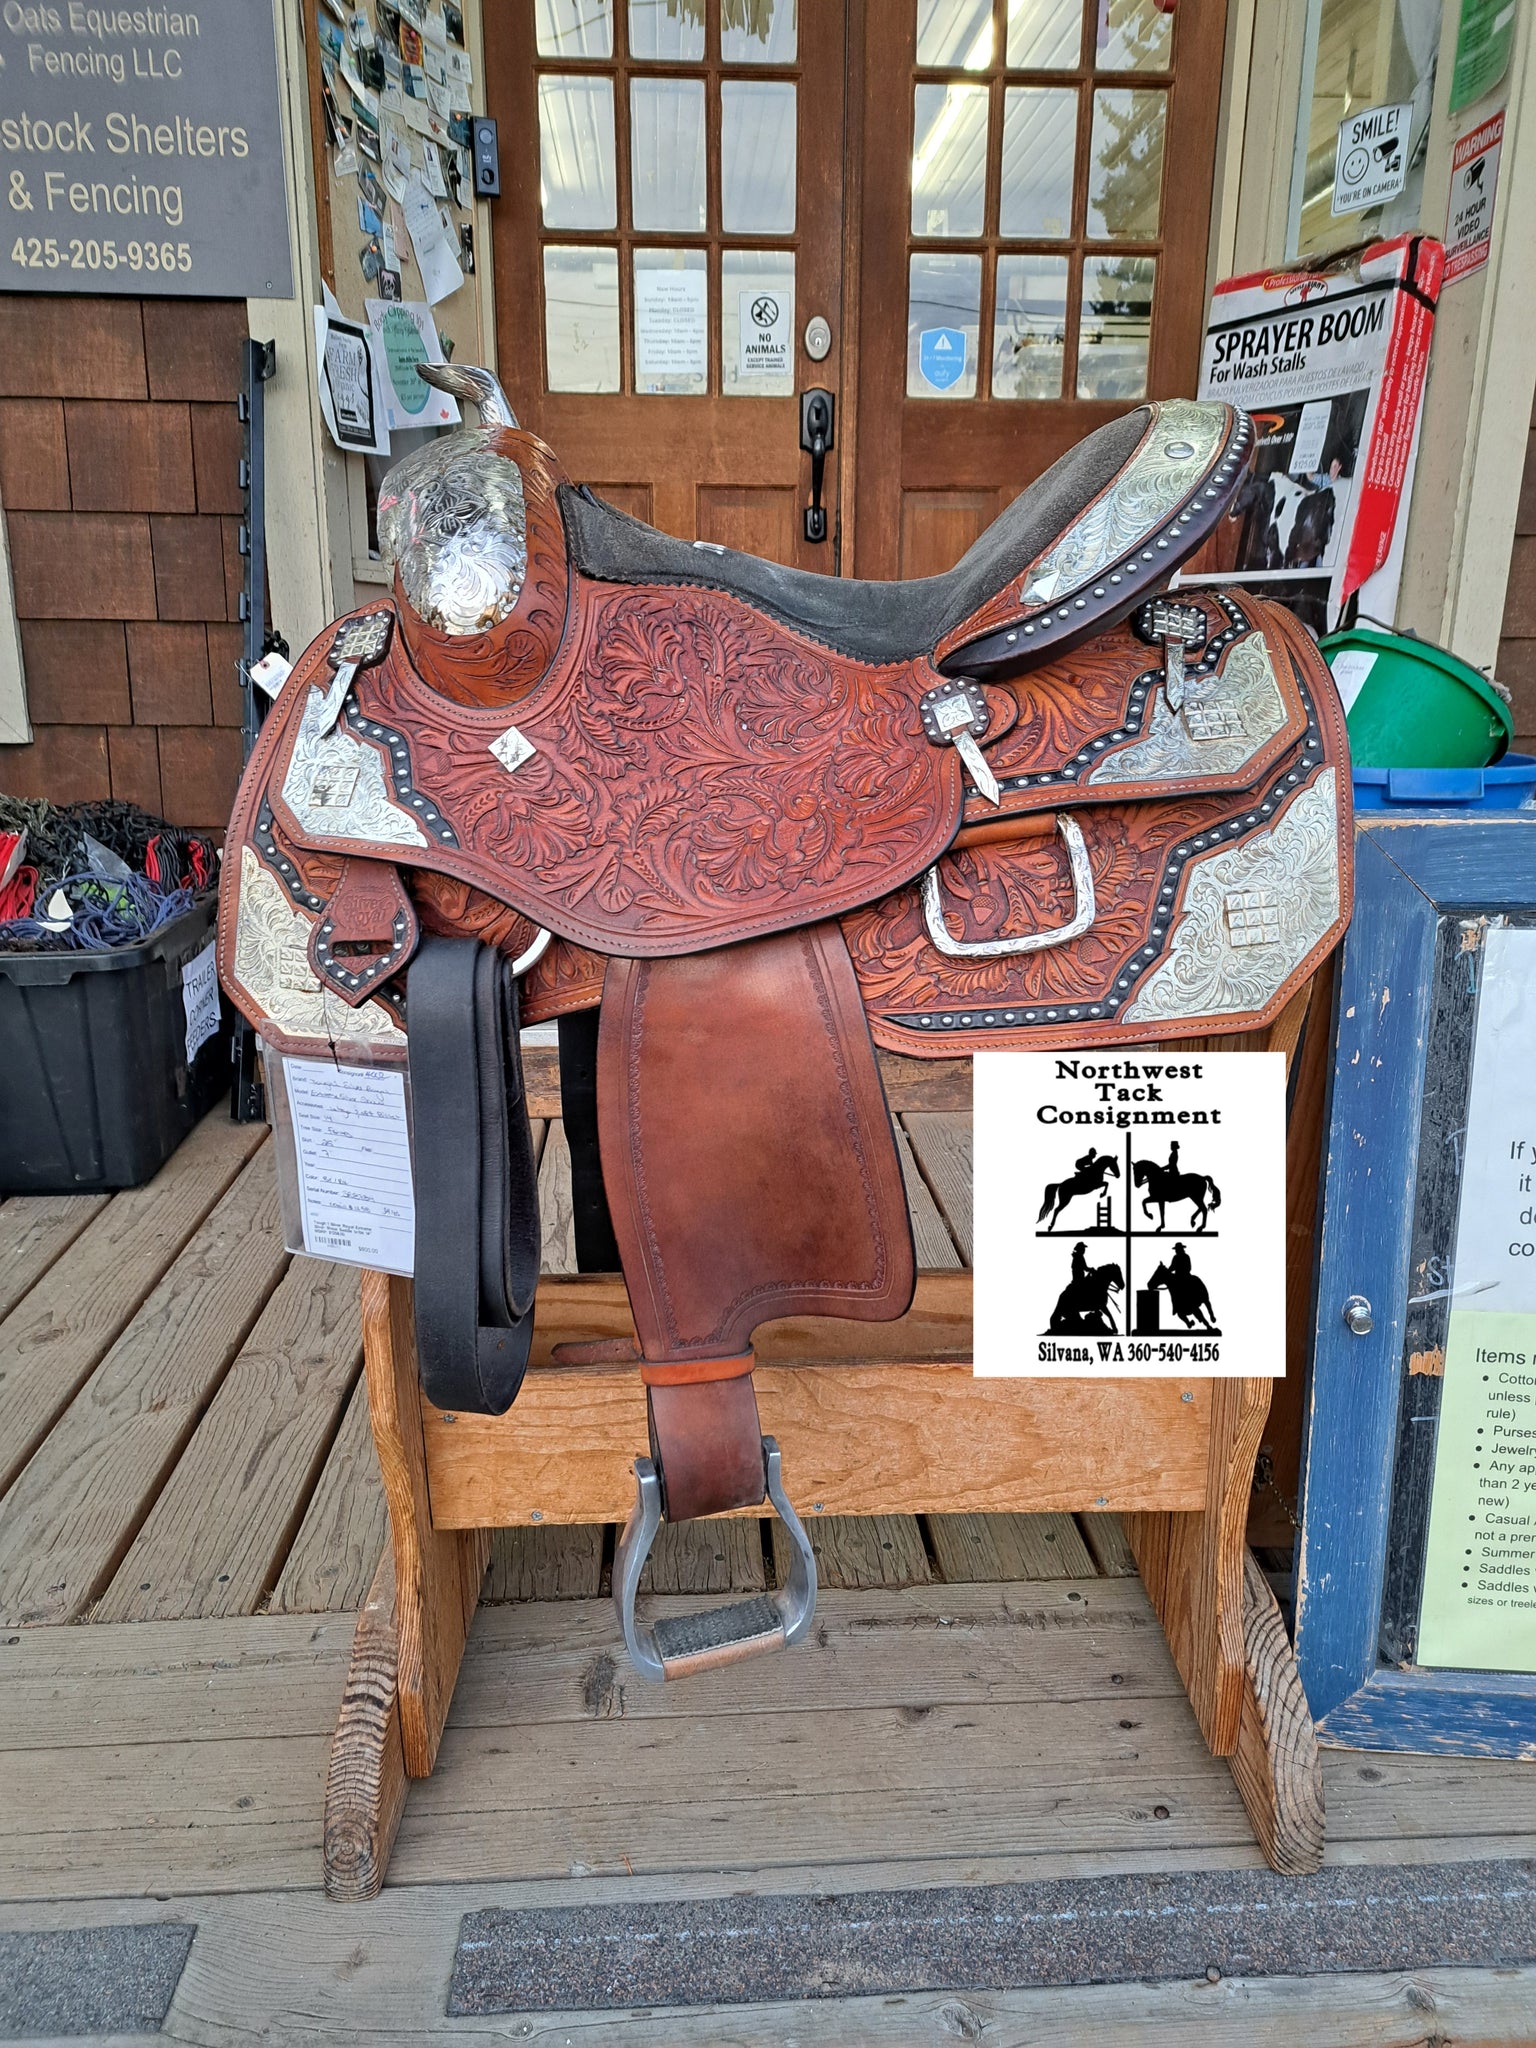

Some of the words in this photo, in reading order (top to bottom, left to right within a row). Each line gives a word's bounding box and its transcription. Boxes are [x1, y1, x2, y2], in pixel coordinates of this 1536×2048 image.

[3, 0, 61, 34] Oats
[68, 2, 200, 38] Equestrian
[28, 44, 124, 82] Fencing
[132, 48, 183, 78] LLC
[105, 112, 249, 157] Shelters
[1352, 109, 1400, 144] SMILE!
[1455, 119, 1502, 164] WARNING
[8, 170, 33, 211] &
[44, 171, 184, 226] Fencing
[1363, 186, 1371, 197] ON
[1373, 179, 1399, 195] CAMERA
[1455, 211, 1463, 227] 24
[1465, 197, 1486, 220] HOUR
[1457, 217, 1480, 239] VIDEO
[1445, 226, 1489, 260] SURVEILLANCE
[11, 237, 193, 272] 425-205-9365
[1450, 243, 1488, 273] TRESPASSING
[759, 333, 771, 342] NO
[1212, 317, 1314, 364] SPRAYER
[1318, 298, 1386, 346] BOOM
[745, 344, 786, 354] ANIMALS
[1384, 376, 1393, 400] ability
[1391, 339, 1400, 366] extend
[1396, 290, 1408, 338] approximat
[1210, 366, 1230, 384] For
[1233, 359, 1267, 380] Wash
[1270, 352, 1306, 375] Stalls
[1380, 432, 1389, 456] install
[186, 961, 215, 998] TRAILER
[187, 1012, 216, 1056] FEEDERS
[1510, 1141, 1526, 1160] If
[1519, 1173, 1532, 1192] it
[1476, 1348, 1526, 1365] Items
[1488, 1391, 1531, 1403] unless
[1486, 1408, 1516, 1422] rule)
[1489, 1460, 1515, 1474] Any
[1479, 1477, 1507, 1489] than
[1511, 1478, 1520, 1489] 2
[1478, 1496, 1510, 1509] new)
[1485, 1512, 1530, 1525] Casual
[1474, 1531, 1495, 1540] not
[1498, 1533, 1506, 1541] a
[1481, 1546, 1535, 1559] Summer
[1479, 1563, 1531, 1575] Saddles
[1477, 1579, 1529, 1593] Saddles
[1467, 1596, 1494, 1605] sizes
[1496, 1599, 1508, 1607] or
